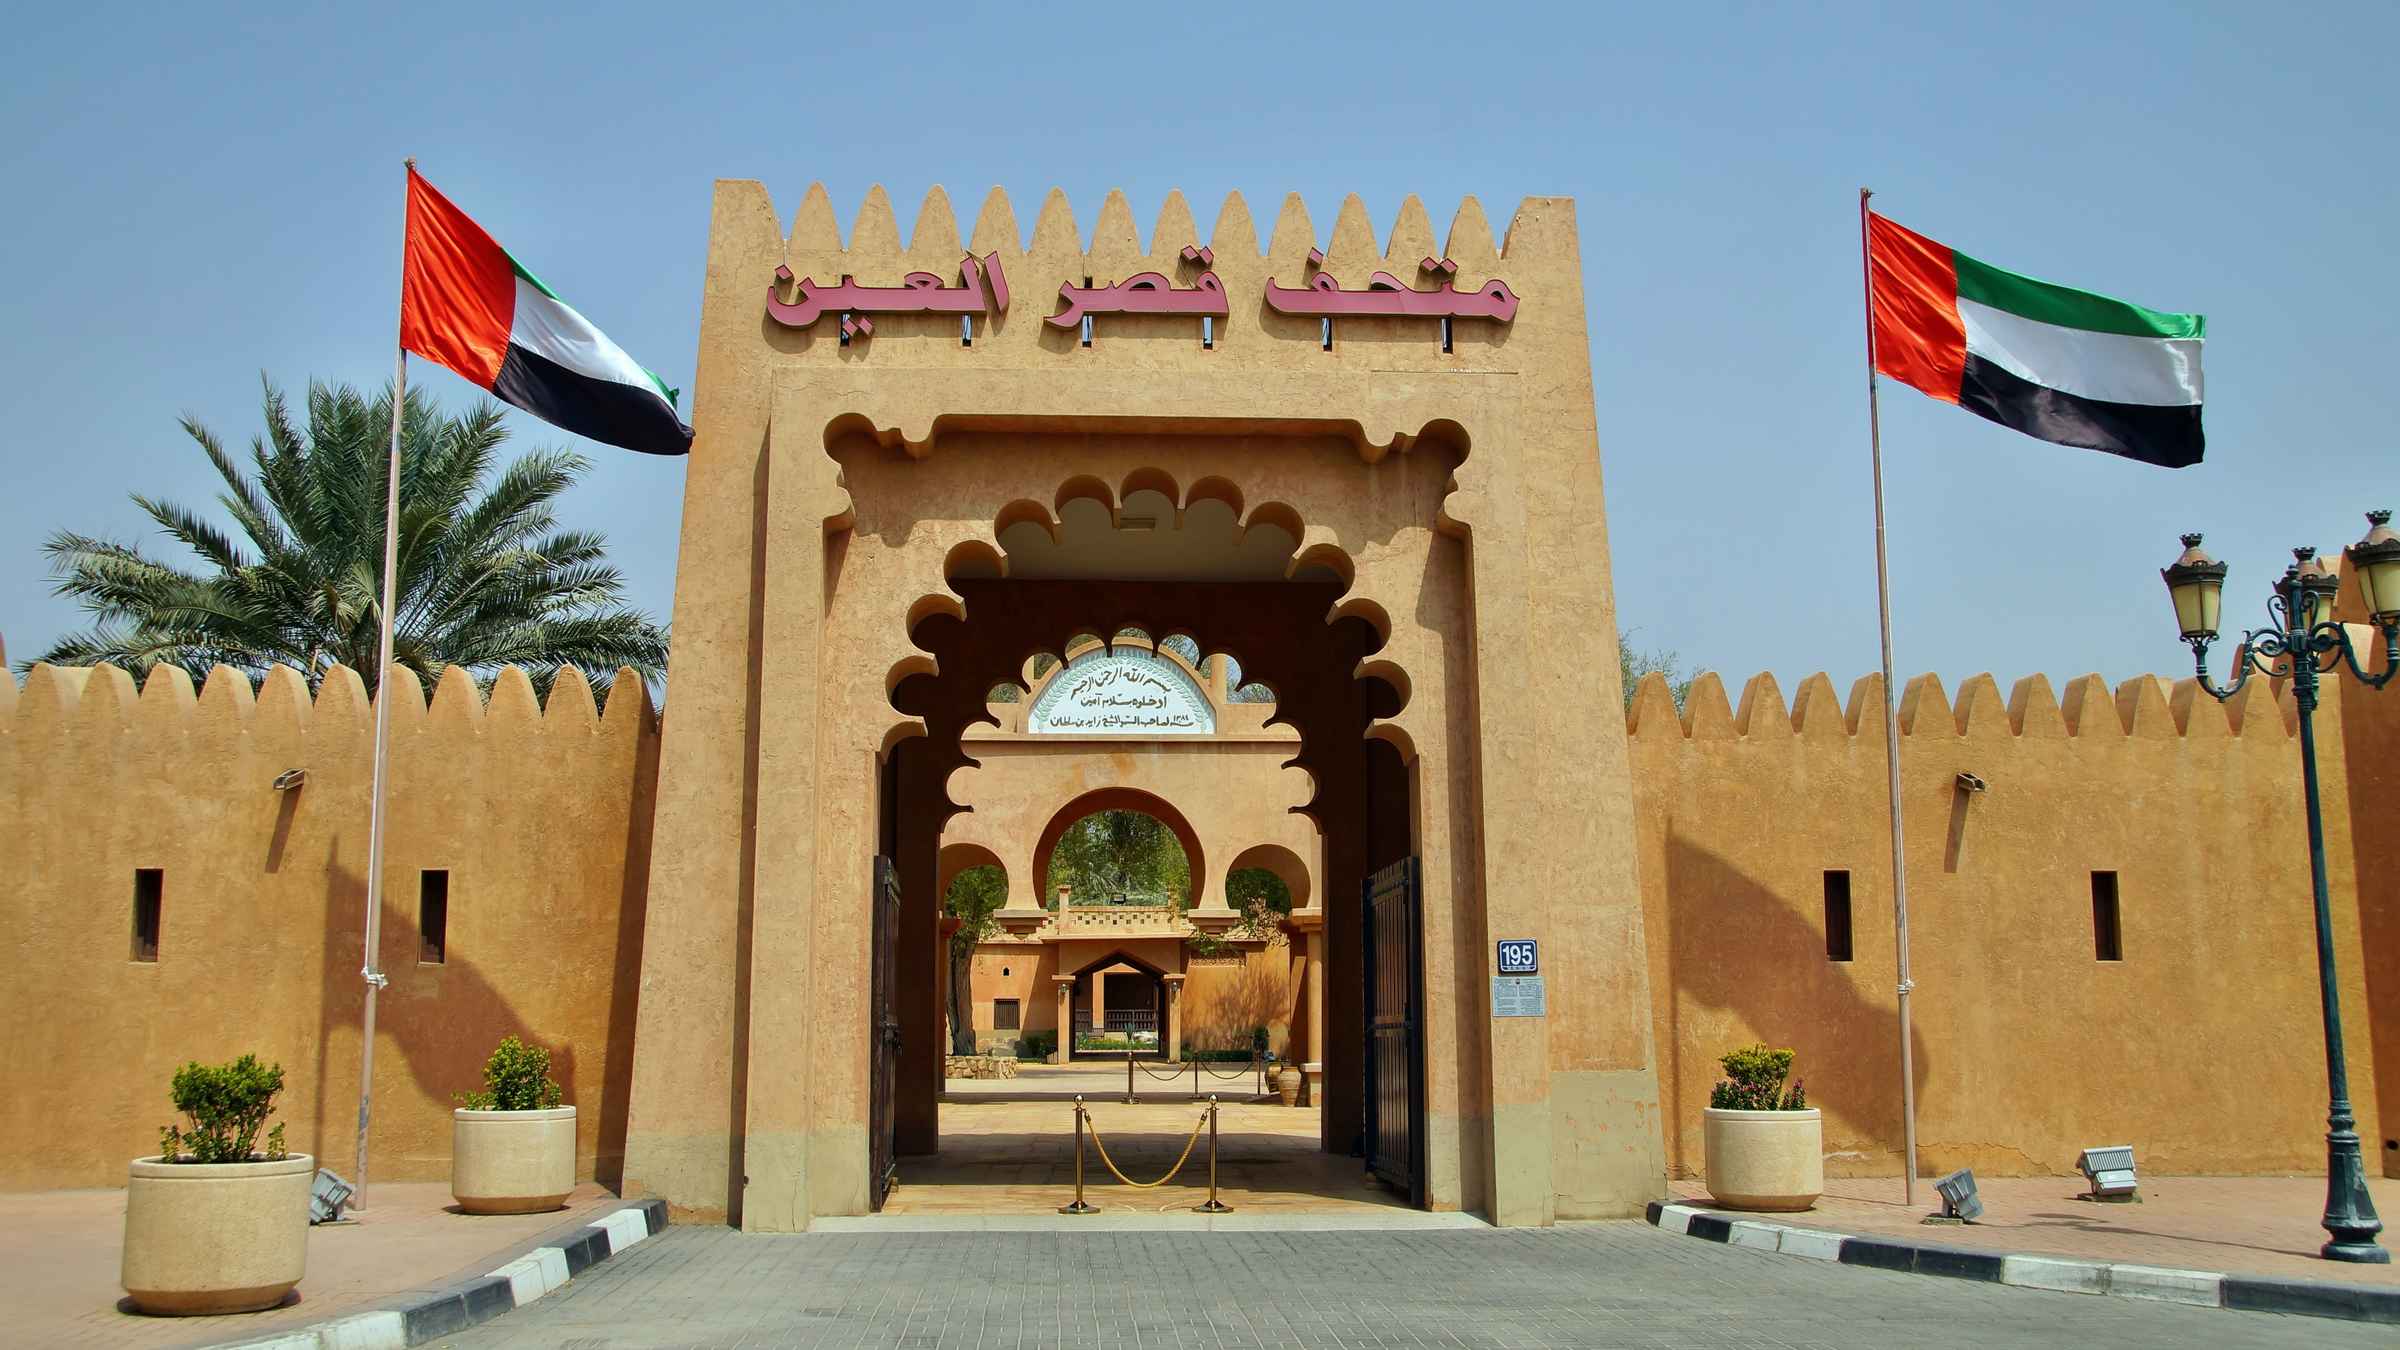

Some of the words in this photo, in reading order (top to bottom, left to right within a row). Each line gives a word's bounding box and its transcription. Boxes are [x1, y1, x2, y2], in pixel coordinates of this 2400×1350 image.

[767, 250, 1009, 337] العين
[1043, 244, 1230, 330] قصر
[1265, 246, 1521, 322] متحف
[1502, 944, 1533, 965] 195
